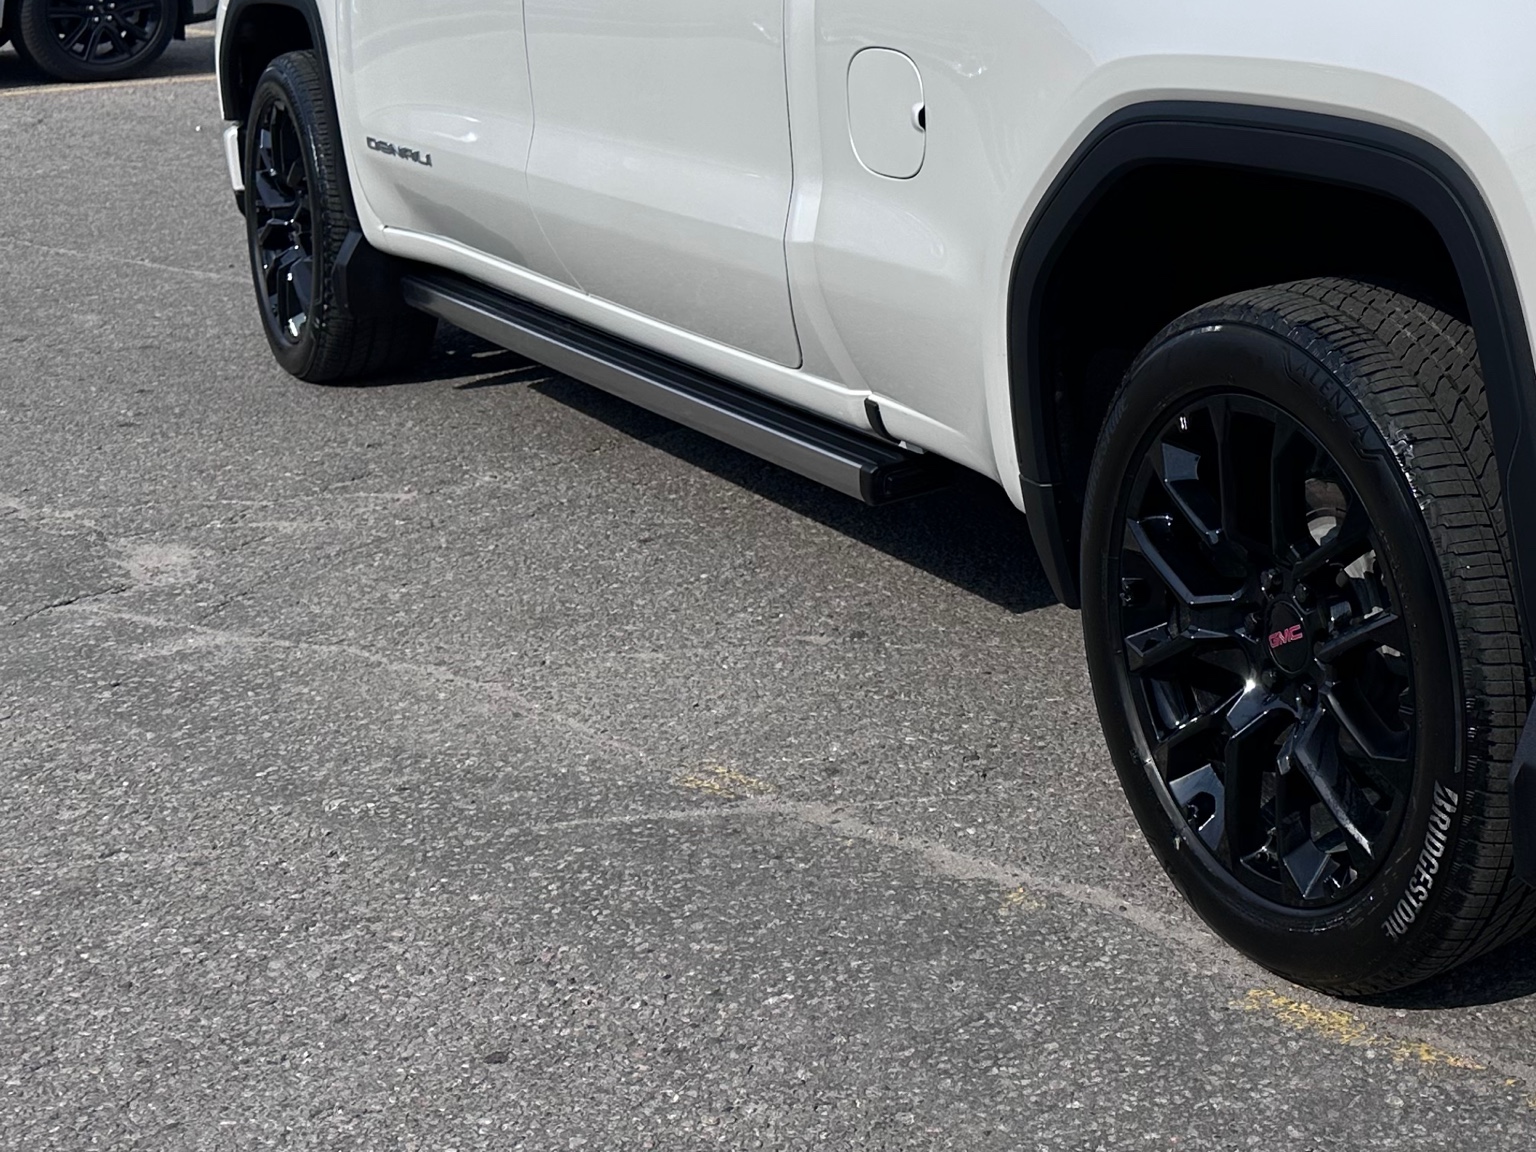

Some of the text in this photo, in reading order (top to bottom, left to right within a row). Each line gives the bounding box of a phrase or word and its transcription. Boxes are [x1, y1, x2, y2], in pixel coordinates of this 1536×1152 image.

[366, 136, 433, 167] DENALI
[1268, 624, 1303, 649] GMC
[1381, 779, 1459, 941] BRIDGESTONE
